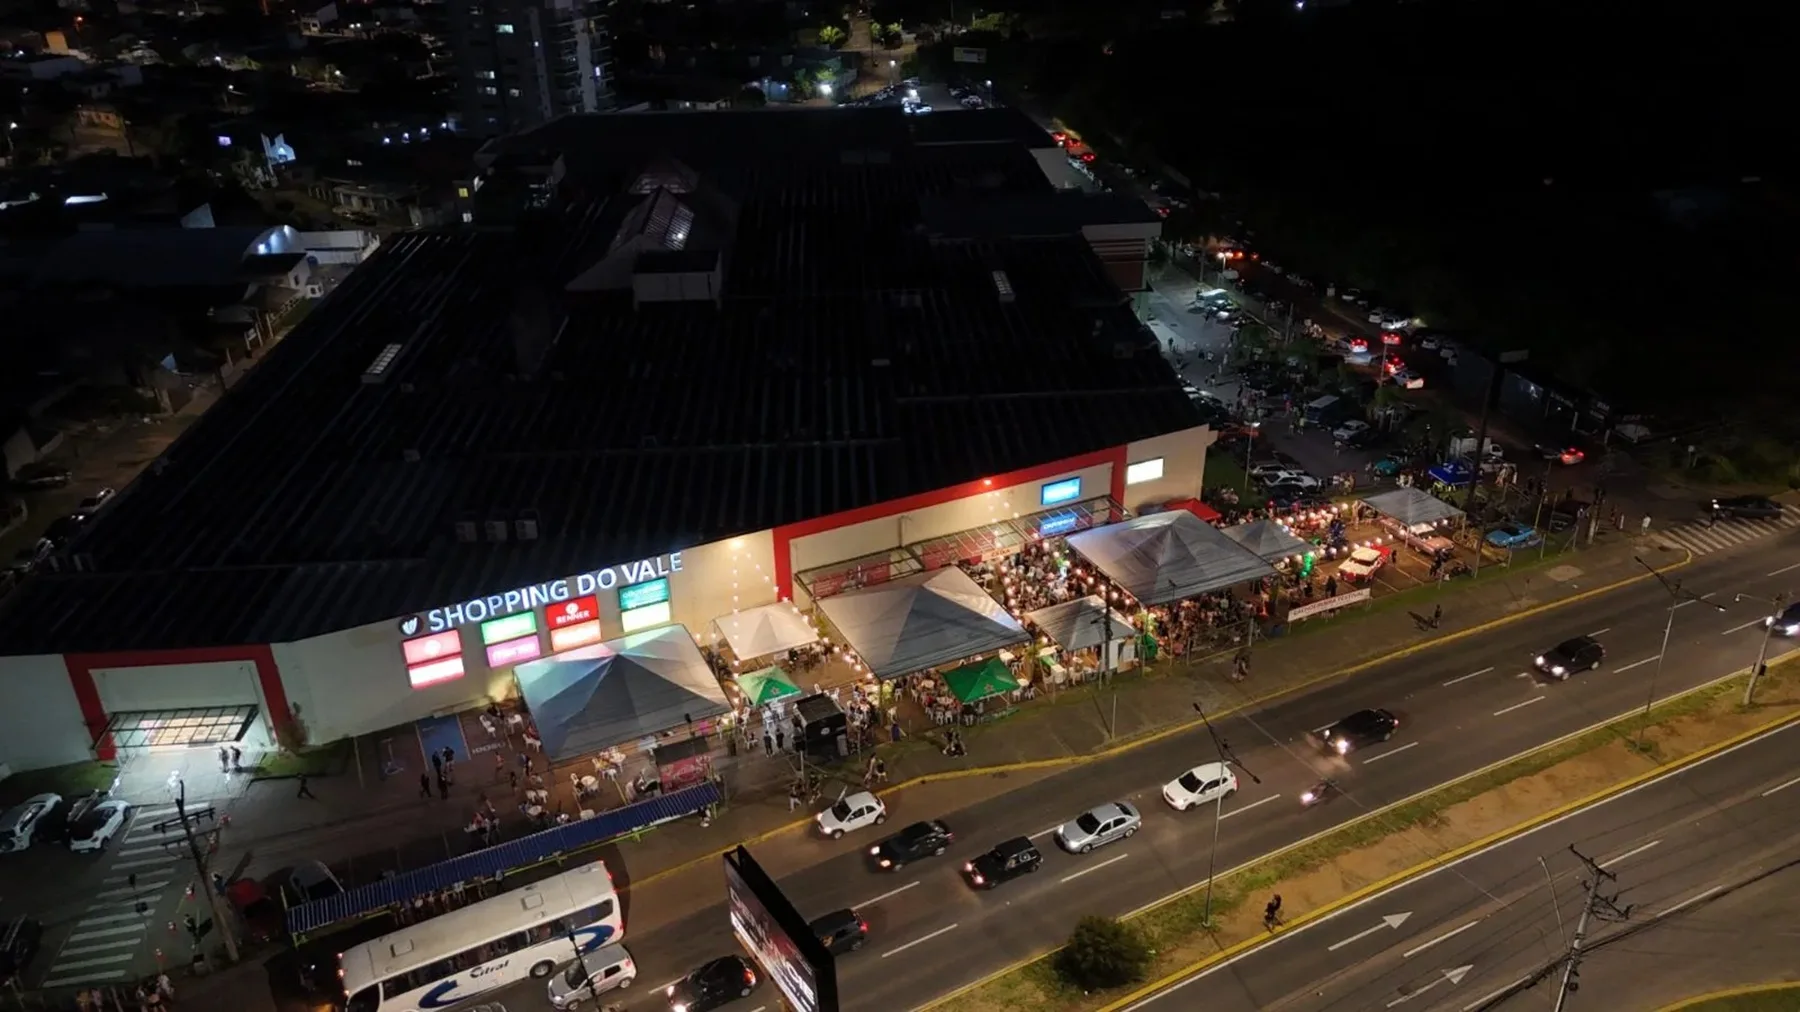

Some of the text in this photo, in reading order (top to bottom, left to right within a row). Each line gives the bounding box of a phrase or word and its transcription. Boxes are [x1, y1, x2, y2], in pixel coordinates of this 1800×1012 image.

[428, 579, 569, 633] SHOPPING
[577, 568, 617, 596] DO
[620, 552, 684, 583] VALE
[556, 609, 590, 624] RENNER
